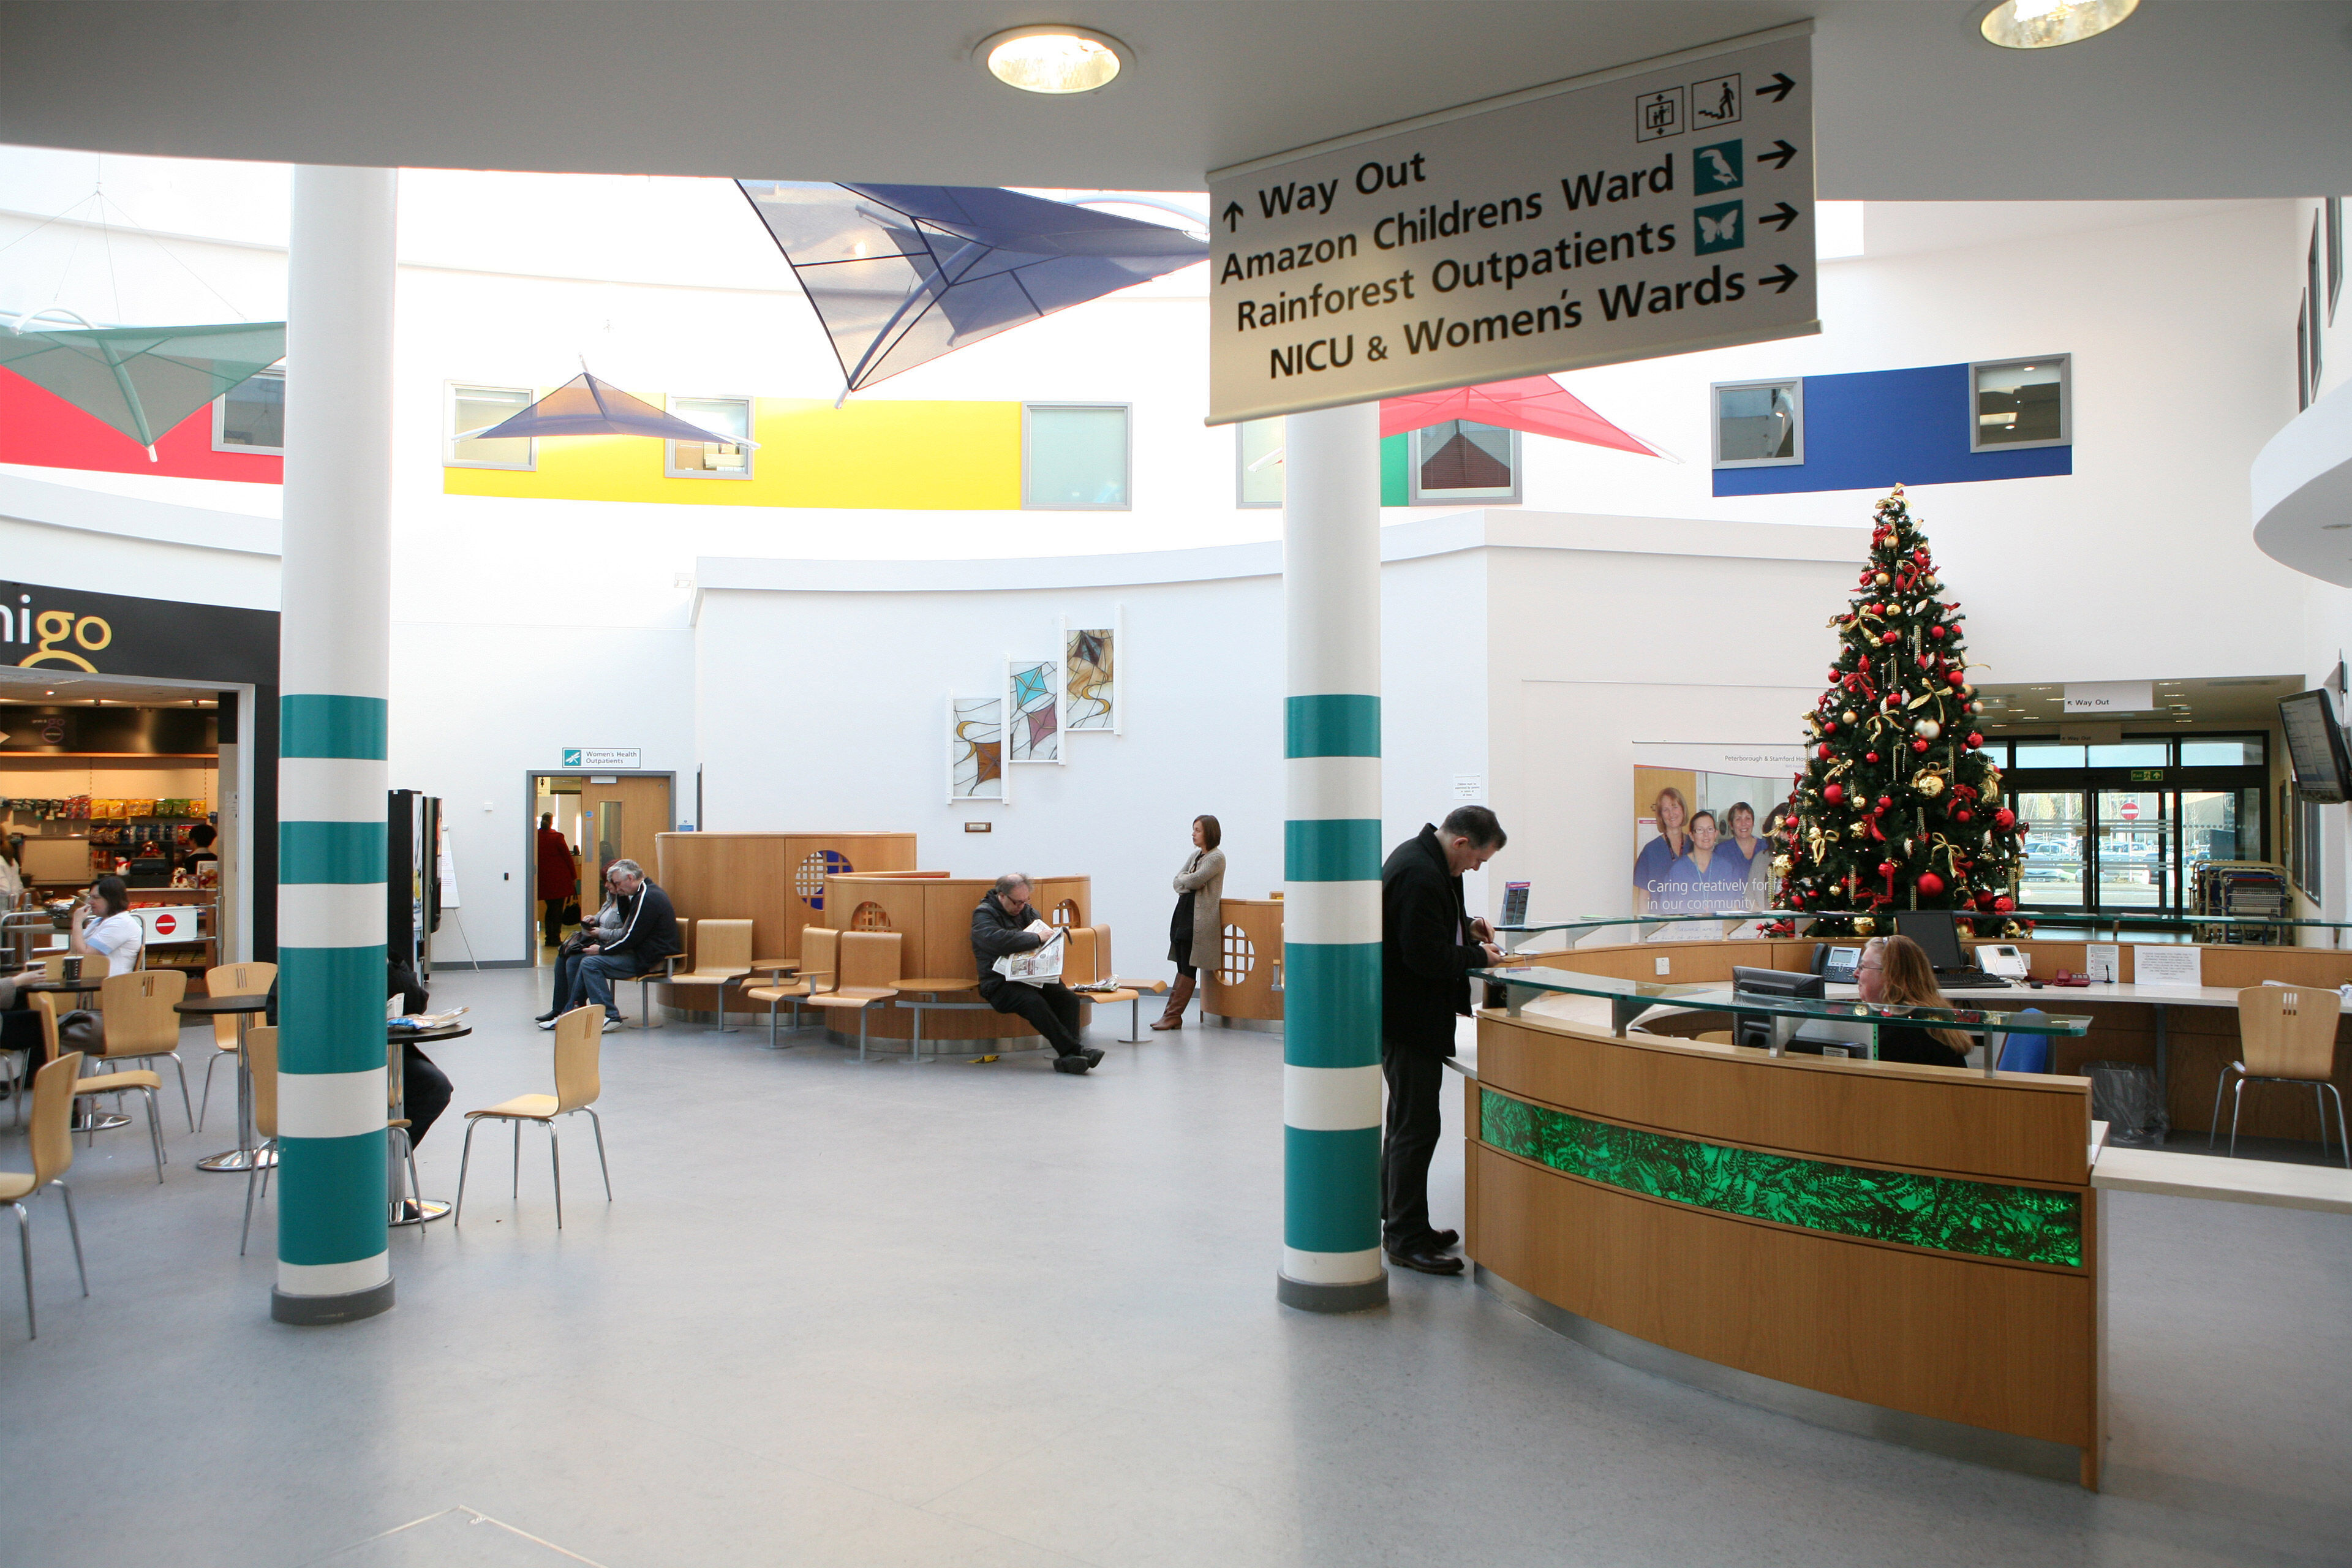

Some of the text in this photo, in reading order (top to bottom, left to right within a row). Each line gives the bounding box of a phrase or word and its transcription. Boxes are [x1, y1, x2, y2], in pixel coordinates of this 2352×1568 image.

[1220, 153, 1674, 285] Amazon Childrens Ward
[1258, 152, 1426, 219] Way Out
[1238, 222, 1676, 332] Rainforest Outpatients
[1270, 264, 1746, 379] NICU & Women's Wards
[1647, 880, 1688, 895] Caring
[1692, 878, 1749, 894] creatively
[1752, 878, 1769, 891] for
[1647, 897, 1755, 911] in our community
